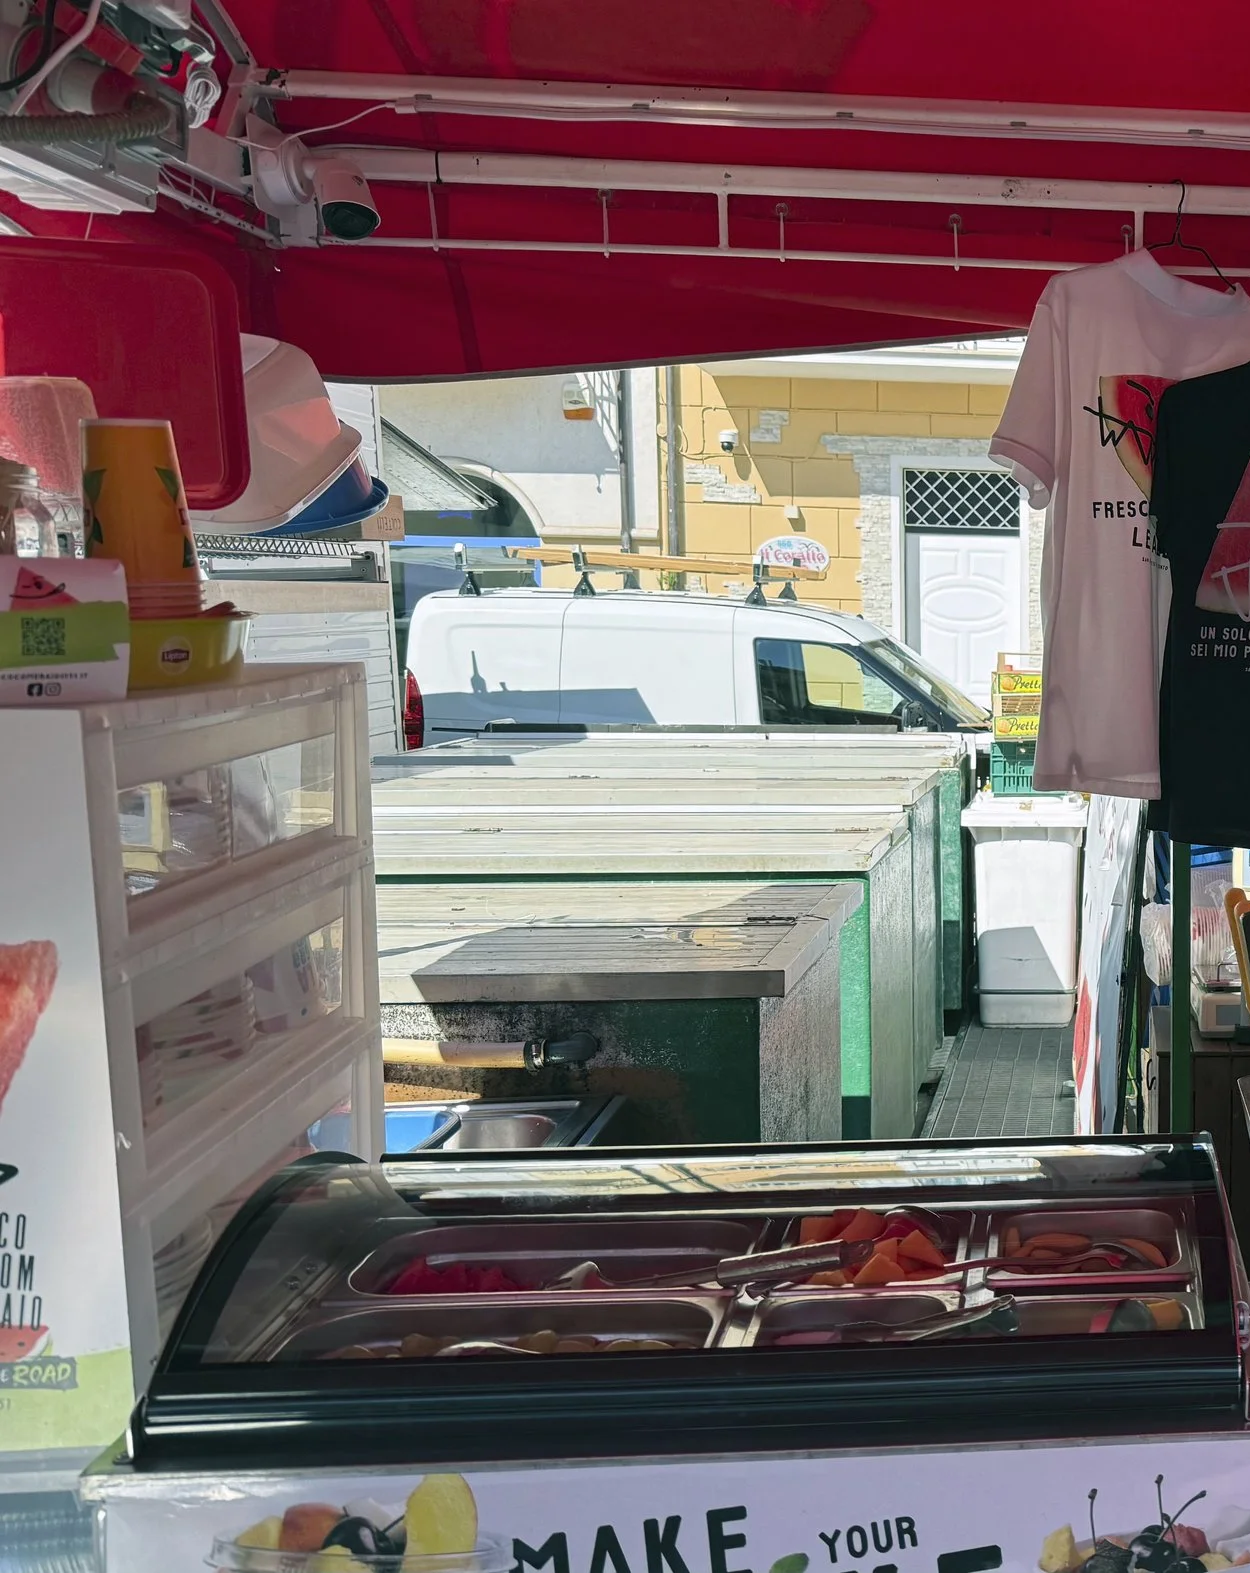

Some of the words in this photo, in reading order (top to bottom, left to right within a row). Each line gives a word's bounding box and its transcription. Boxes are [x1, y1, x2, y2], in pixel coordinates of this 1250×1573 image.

[1092, 500, 1149, 518] FRESC
[1200, 626, 1216, 640] UN
[1190, 644, 1208, 656] SEI
[1214, 644, 1237, 658] MIO
[12, 1362, 72, 1386] ROAD
[509, 1505, 754, 1573] MAKE
[818, 1516, 918, 1564] YOUR
